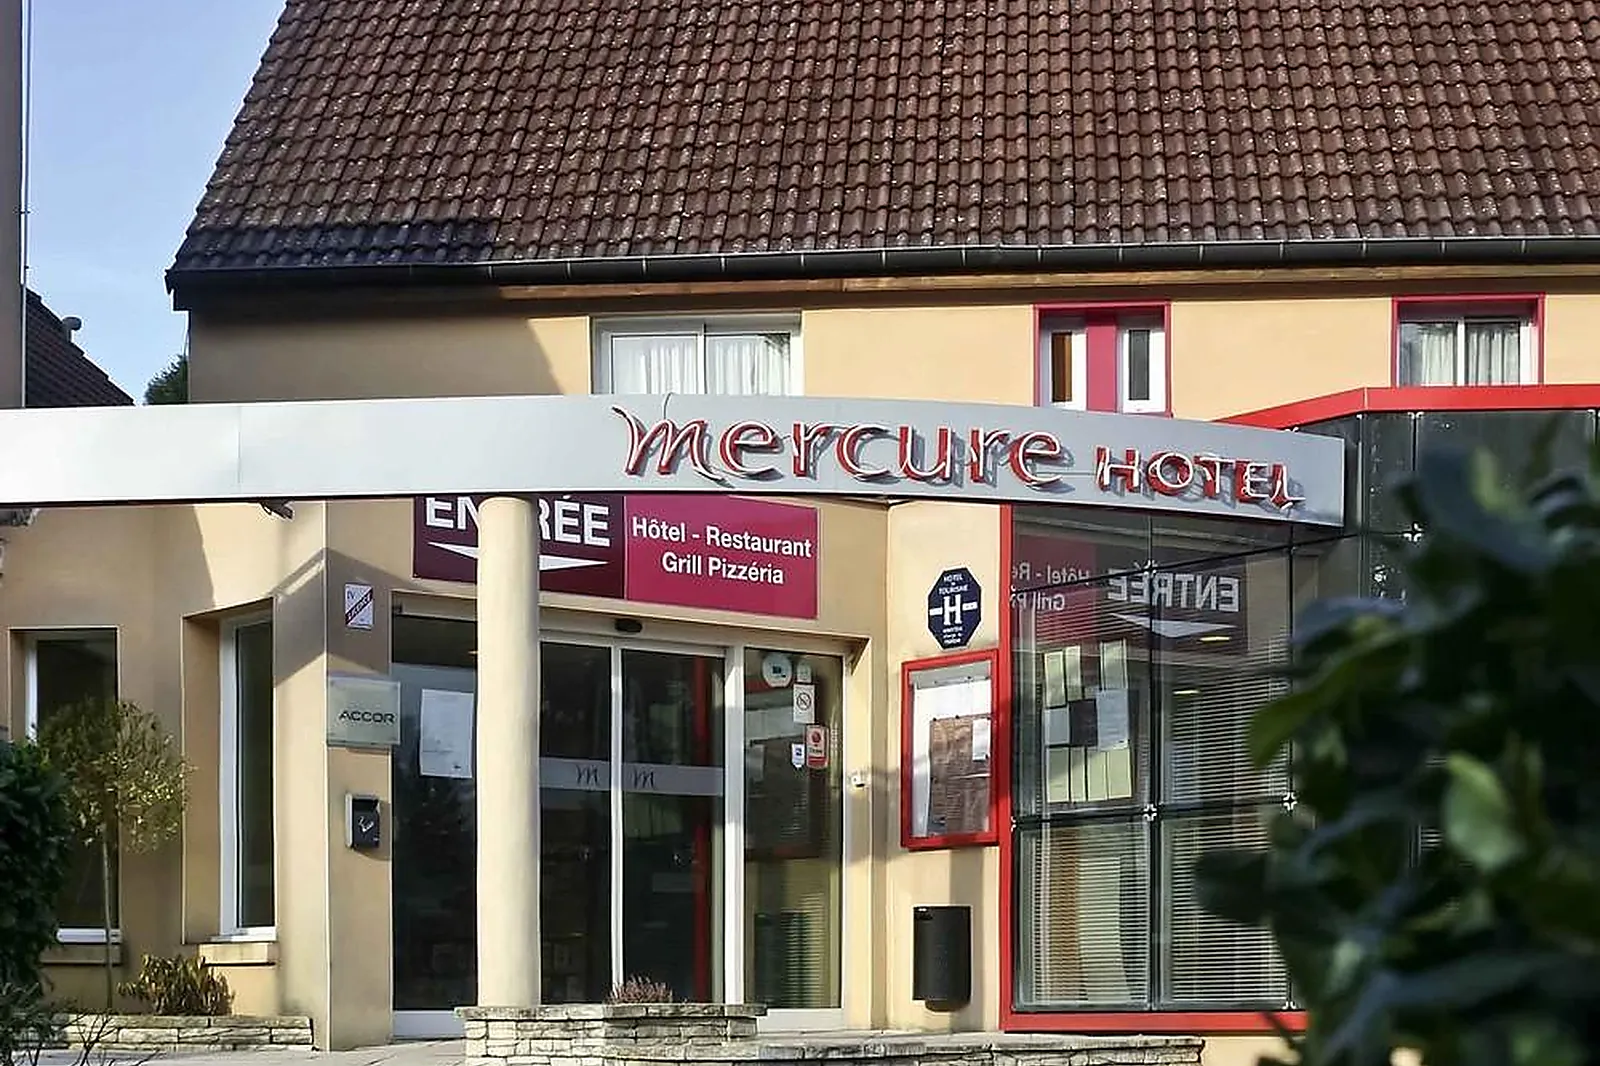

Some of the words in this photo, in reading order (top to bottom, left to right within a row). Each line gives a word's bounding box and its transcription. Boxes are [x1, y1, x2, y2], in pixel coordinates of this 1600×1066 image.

[1096, 447, 1306, 509] HOTEL
[426, 494, 611, 547] ENRÉE
[632, 516, 686, 543] Hôtel
[706, 525, 812, 558] Restaurant
[662, 551, 702, 575] Grill
[708, 556, 784, 584] Pizzéria
[943, 593, 962, 626] H
[339, 710, 395, 724] ACCOR
